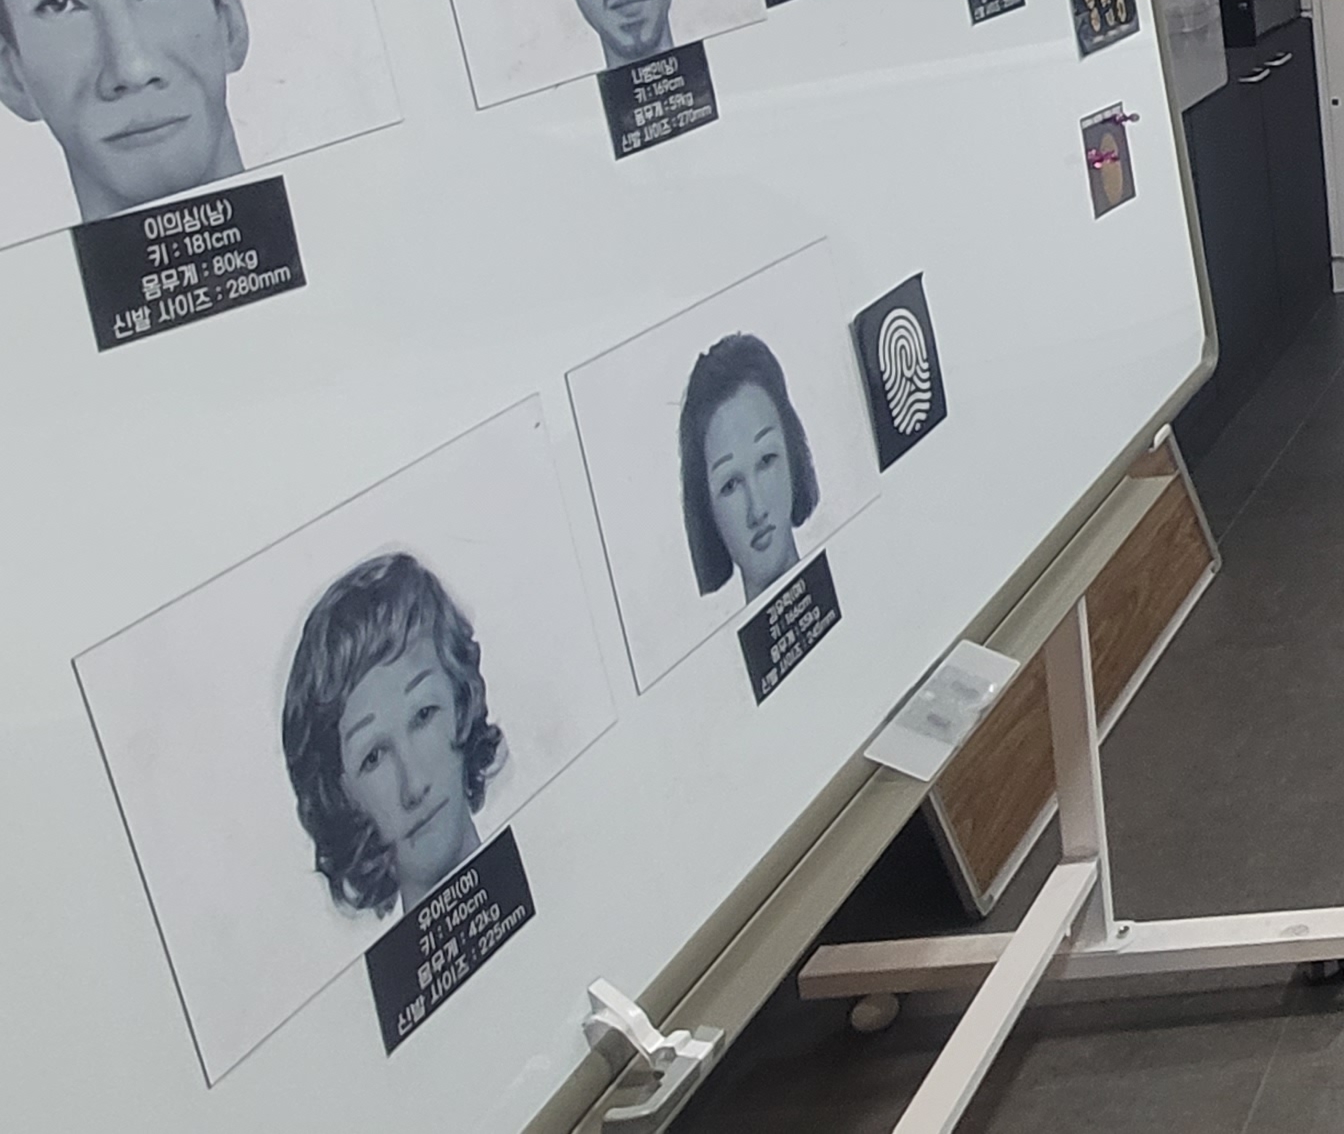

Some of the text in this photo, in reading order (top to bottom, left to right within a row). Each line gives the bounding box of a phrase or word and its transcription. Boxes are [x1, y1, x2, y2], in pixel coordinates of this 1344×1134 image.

[143, 198, 233, 240] 이의심(남)
[146, 245, 169, 267] 키
[183, 227, 242, 256] 181cm
[113, 306, 151, 339] 신발
[158, 287, 213, 323] 사이즈
[226, 266, 292, 300] 280mm
[141, 263, 199, 301] 몸무게
[212, 249, 259, 275] 80kg
[417, 936, 459, 990] 몸무게
[468, 903, 501, 938] 42kg
[419, 931, 436, 956] 키
[445, 888, 488, 933] 140cm
[398, 994, 426, 1036] 신발
[430, 954, 470, 1006] 사이즈
[478, 905, 526, 956] 225mm
